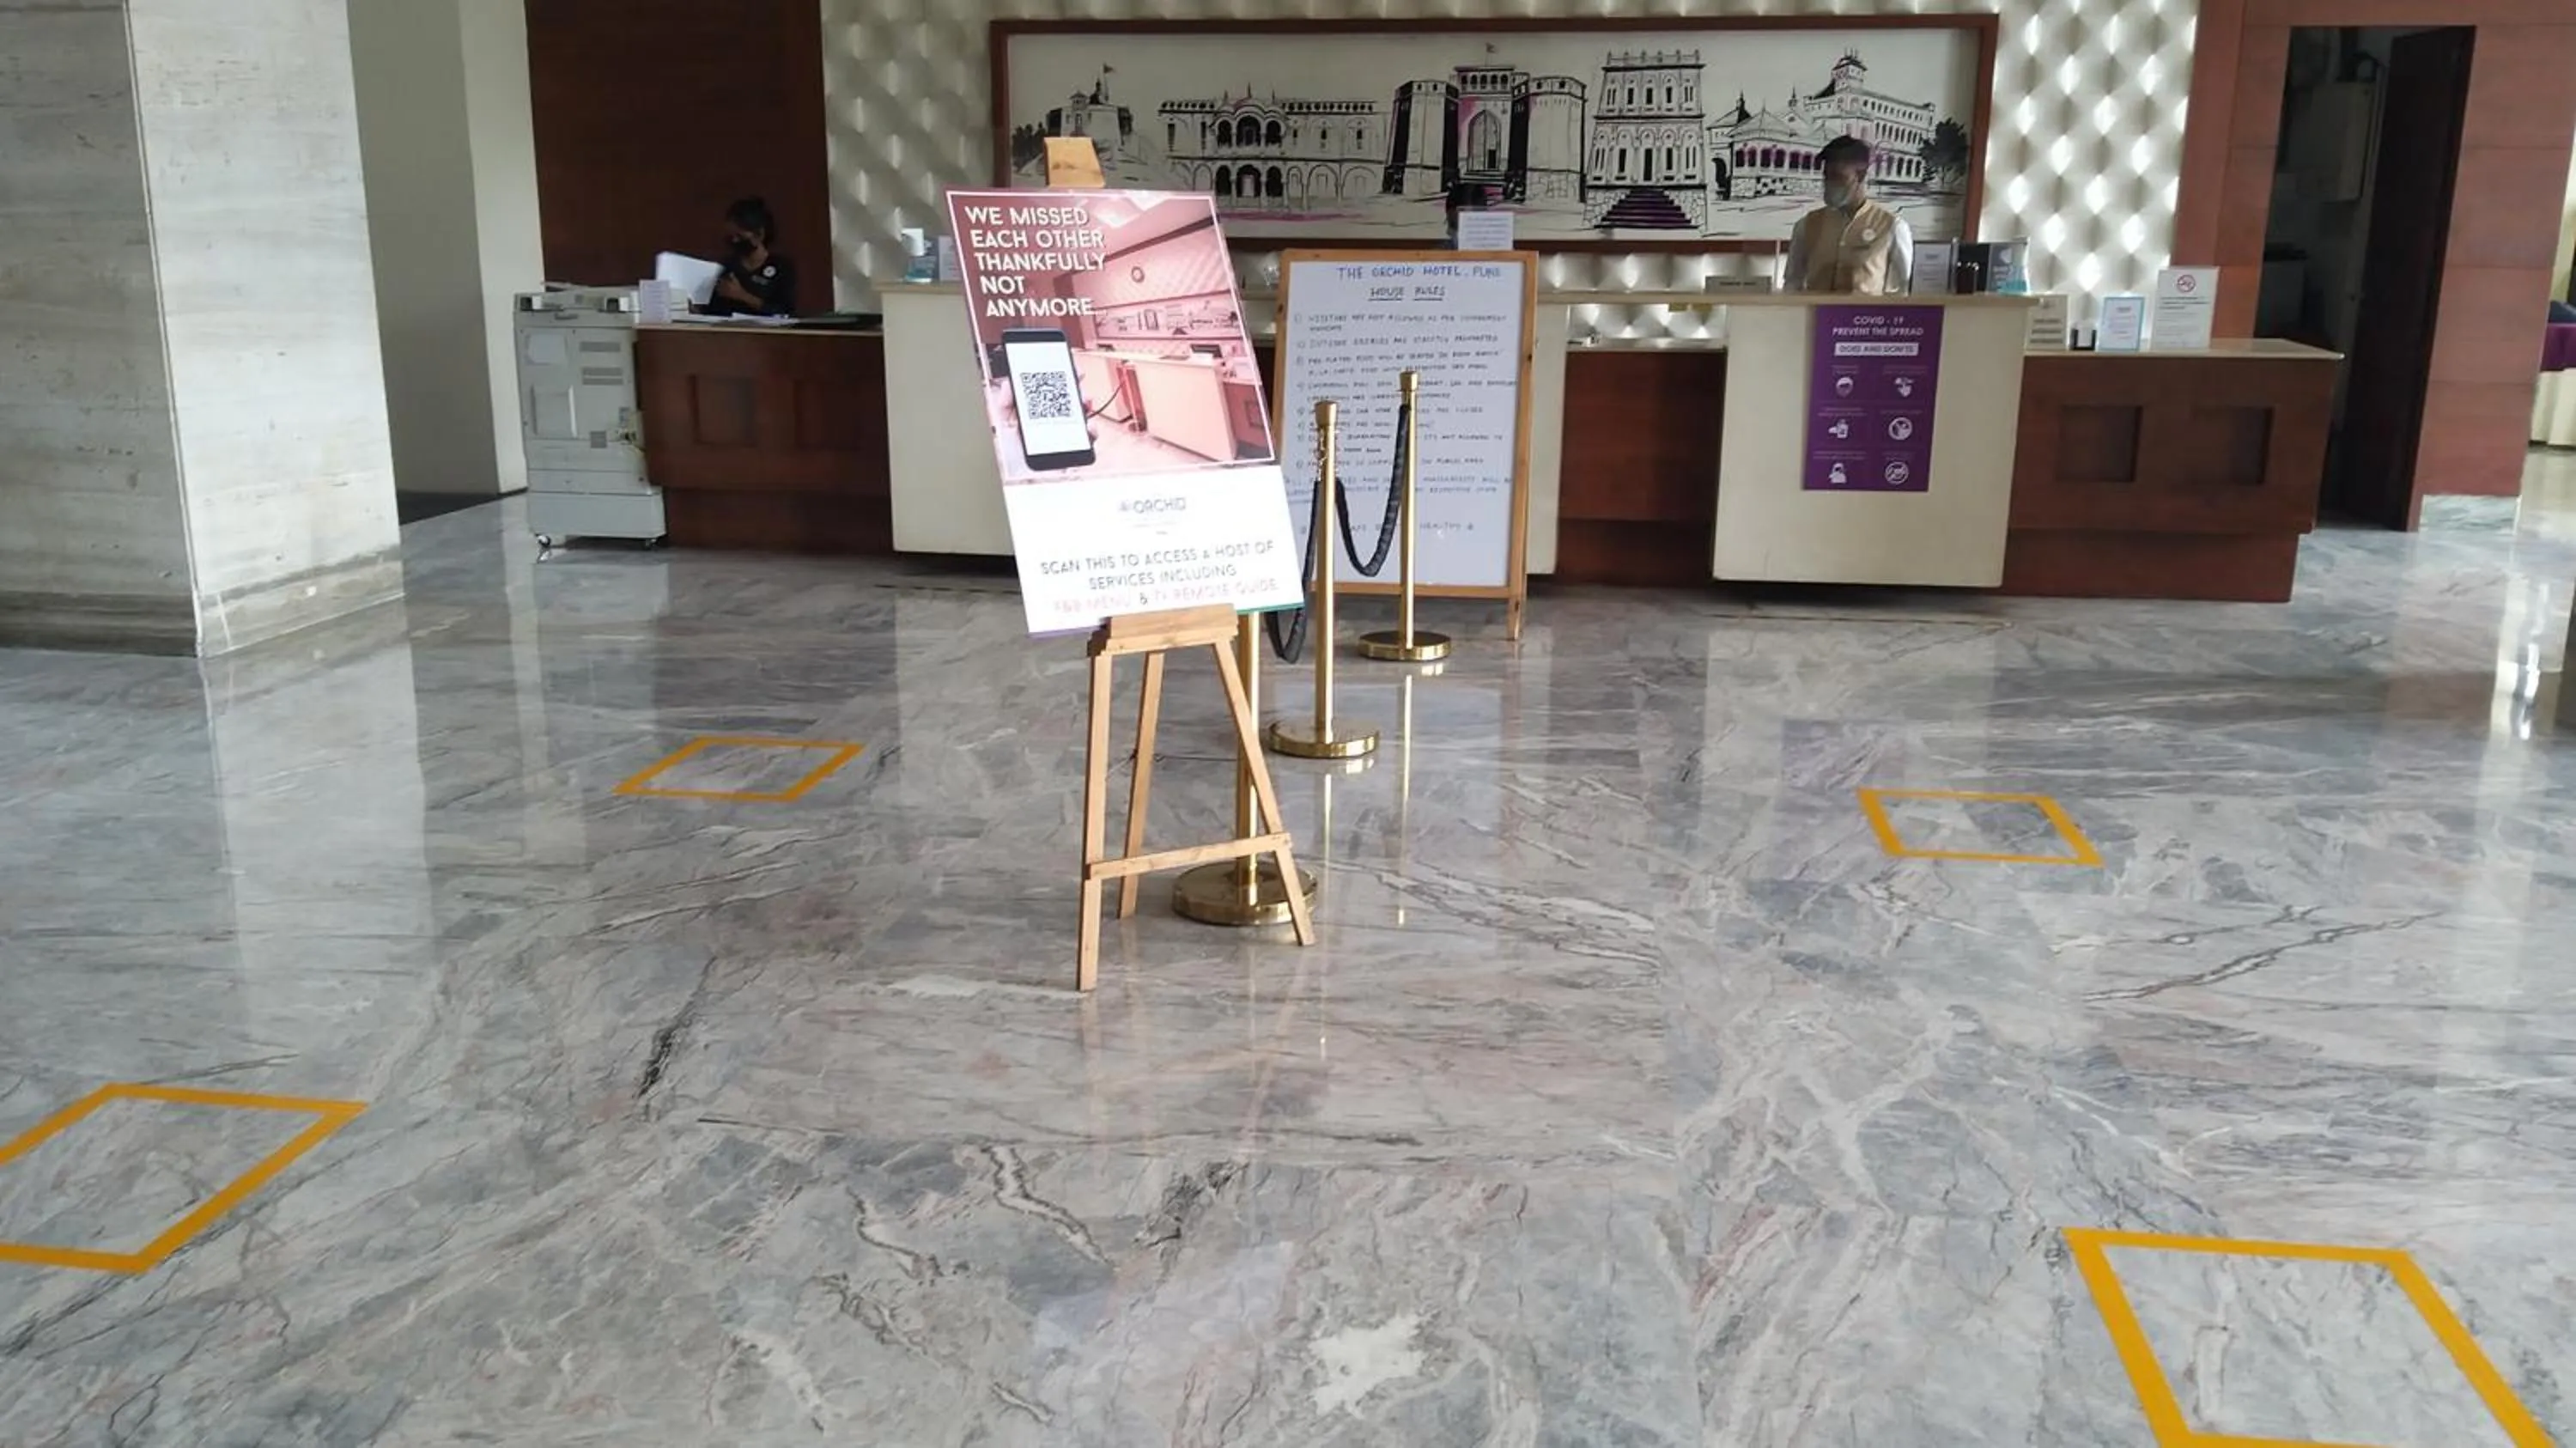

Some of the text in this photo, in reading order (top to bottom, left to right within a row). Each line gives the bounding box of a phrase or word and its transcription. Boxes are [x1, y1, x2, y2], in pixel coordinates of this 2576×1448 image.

[965, 206, 1089, 226] WE MISSED
[970, 229, 1105, 248] EACH OTHER
[975, 252, 1105, 271] THANKFULLY
[1337, 266, 1363, 280] THE
[980, 276, 1025, 294] NOT
[1853, 316, 1885, 325] COVID
[1832, 327, 1923, 336] PREVENT THE SPREAD
[1133, 496, 1186, 514] ORCHID
[1040, 560, 1080, 575] SCAN
[1085, 556, 1116, 570] THIS
[1121, 553, 1140, 567] TO
[1145, 548, 1198, 565] ACCESS
[1215, 542, 1250, 558] HOST
[1255, 539, 1275, 555] OF
[1089, 563, 1237, 590] SERVICES INCLUDING
[1173, 583, 1230, 600] REMOTE
[1234, 577, 1280, 595] GUIDE
